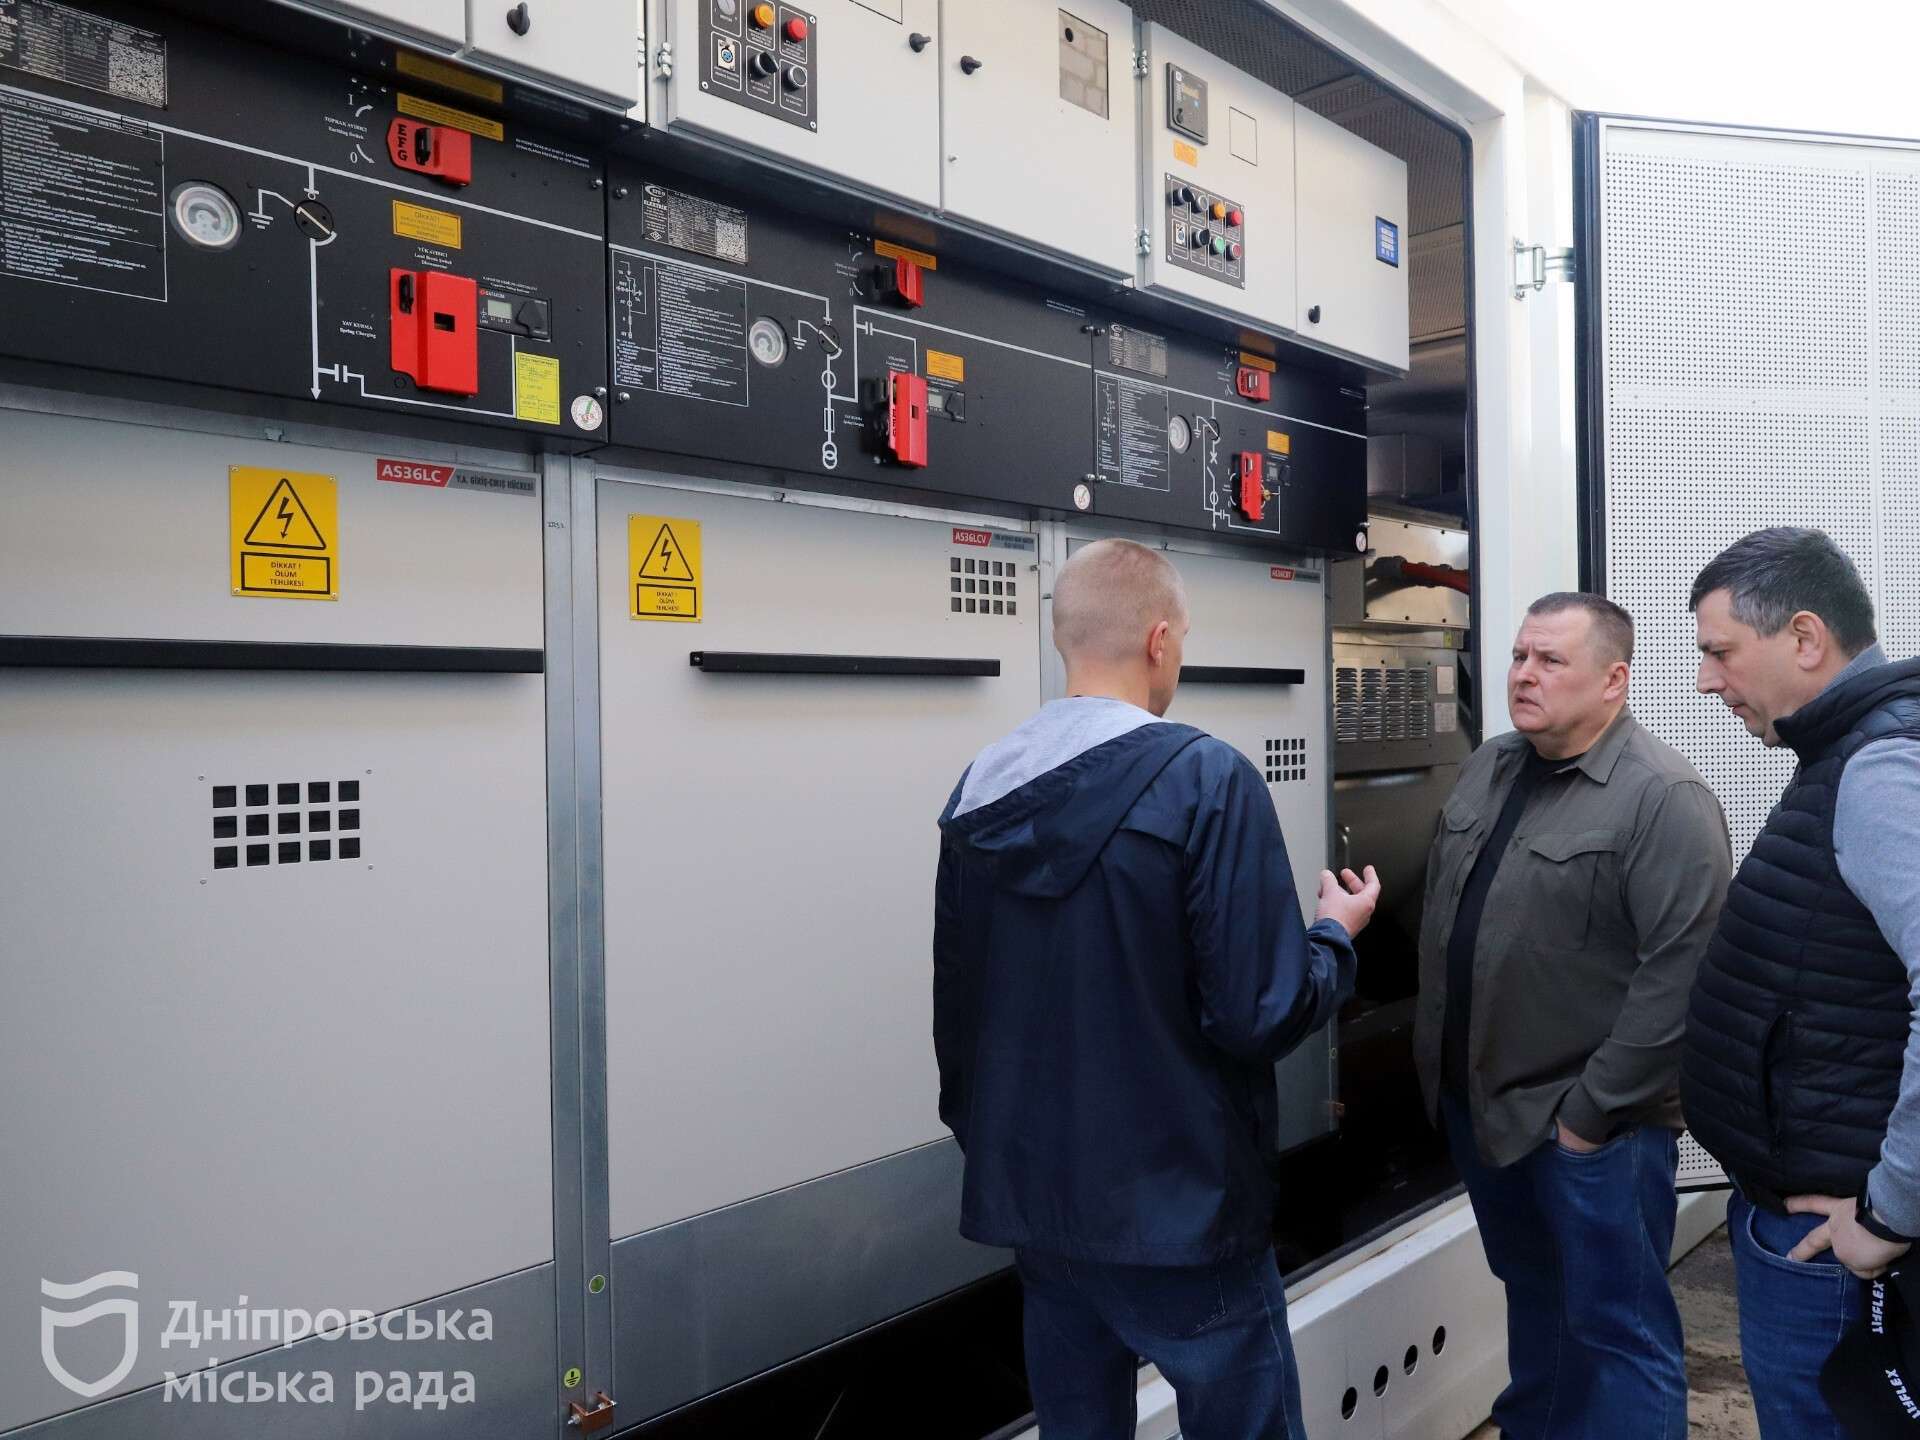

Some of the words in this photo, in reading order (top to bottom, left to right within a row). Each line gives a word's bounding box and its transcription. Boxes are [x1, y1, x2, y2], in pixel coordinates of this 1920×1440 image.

[382, 464, 441, 483] AS36LC
[270, 561, 296, 569] DİKKAT
[274, 570, 297, 578] ÖLÜM
[270, 578, 304, 587] TEHLİKESİ
